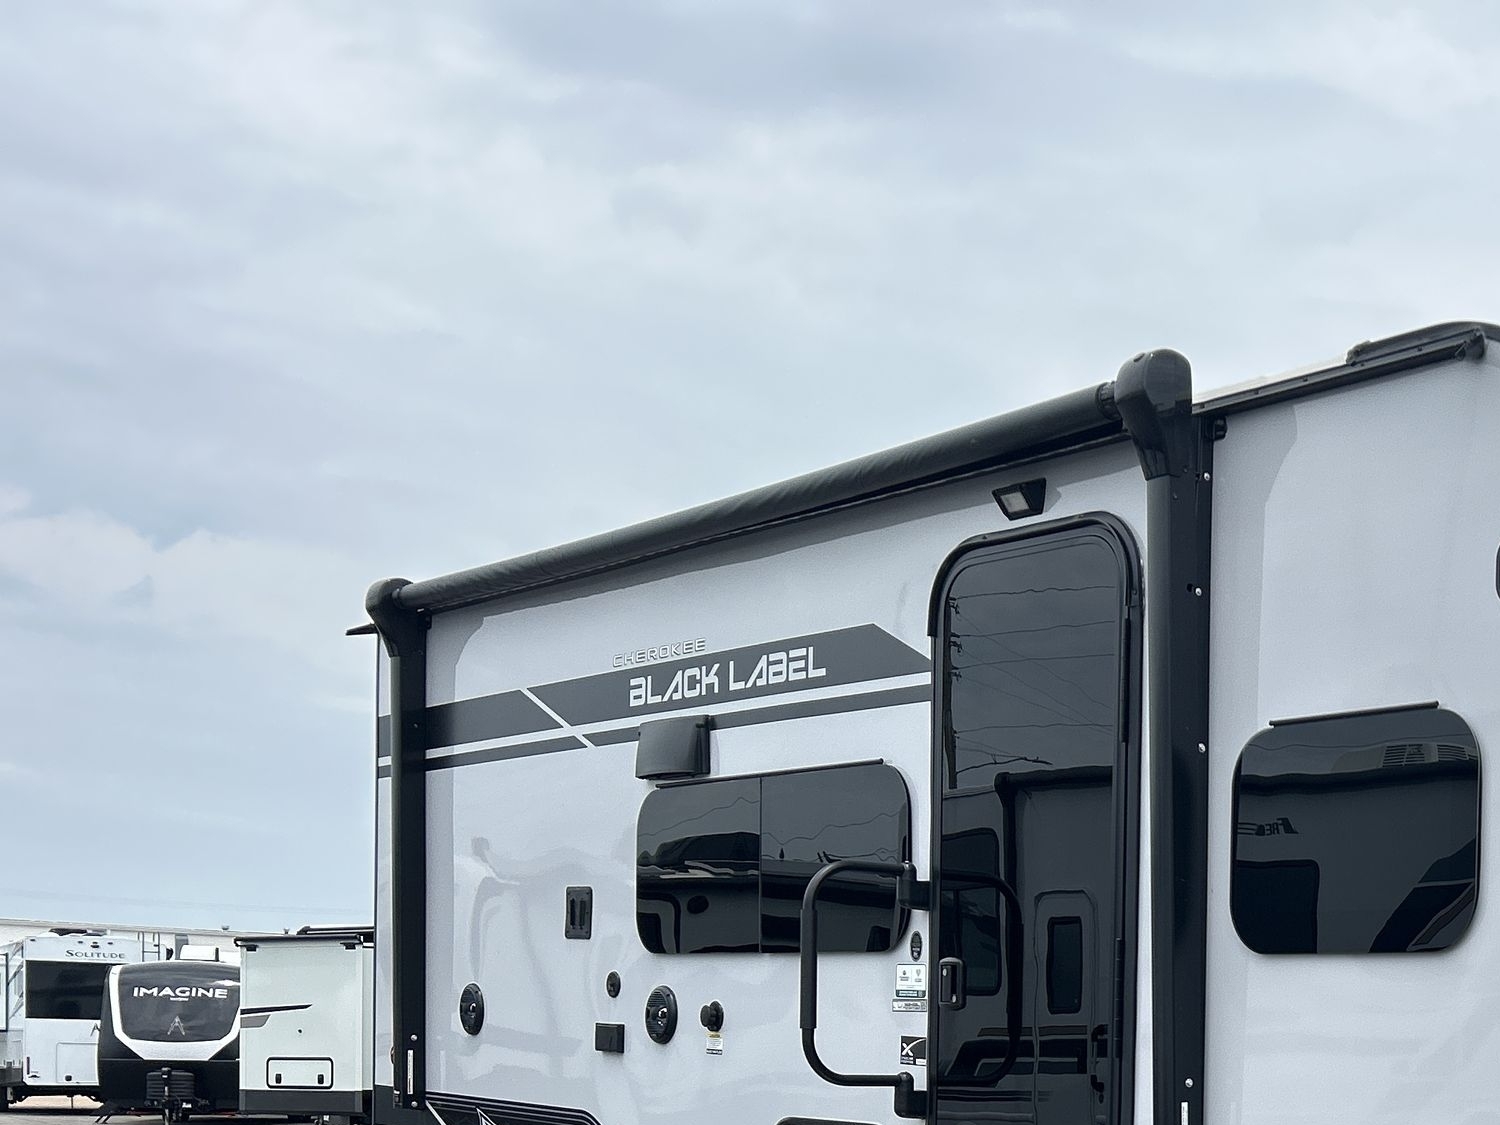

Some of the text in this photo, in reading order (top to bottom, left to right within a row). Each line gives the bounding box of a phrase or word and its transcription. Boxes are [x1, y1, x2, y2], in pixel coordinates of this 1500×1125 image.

[612, 638, 706, 667] CHEROKEE
[629, 646, 826, 707] BLACK LABEL
[65, 949, 126, 959] SOLITUDE
[132, 986, 228, 999] IMAGINE
